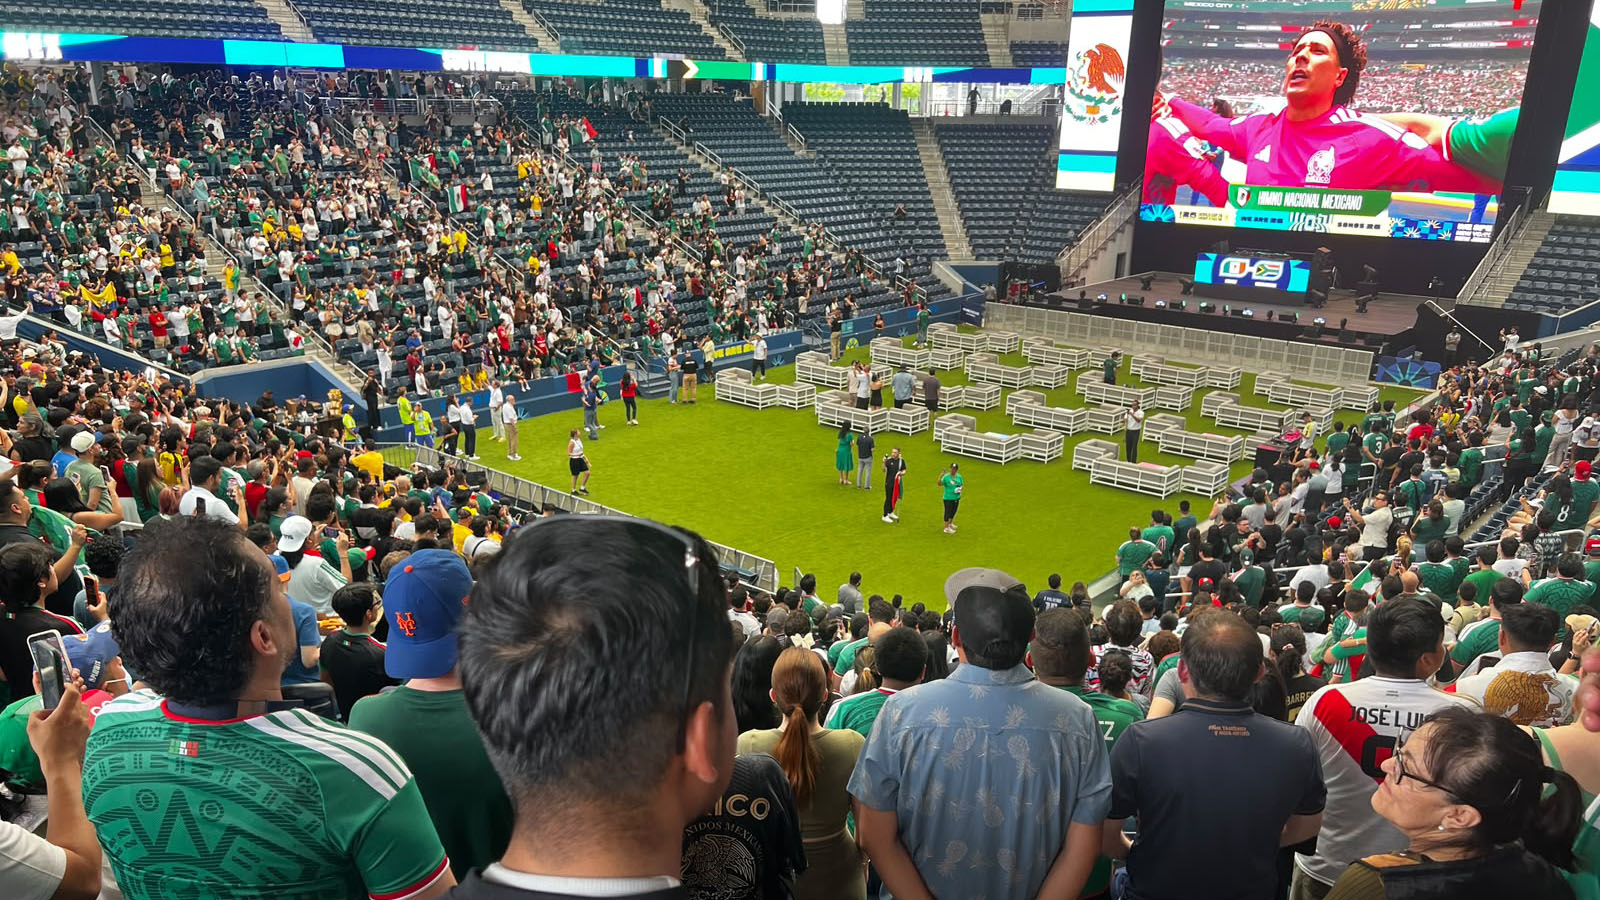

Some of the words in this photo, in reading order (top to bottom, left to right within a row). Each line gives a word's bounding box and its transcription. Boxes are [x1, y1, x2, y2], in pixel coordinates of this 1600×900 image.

[1258, 190, 1283, 206] HIMNO
[1284, 191, 1320, 208] NACIONAL
[1321, 194, 1363, 211] MEXICANO
[1375, 441, 1383, 454] 3
[1556, 504, 1570, 522] 8
[1286, 691, 1315, 705] BARRE
[1348, 704, 1391, 726] JOSÉ
[1394, 710, 1426, 729] LUI
[708, 793, 771, 820] ICO
[684, 820, 722, 836] NIDOS
